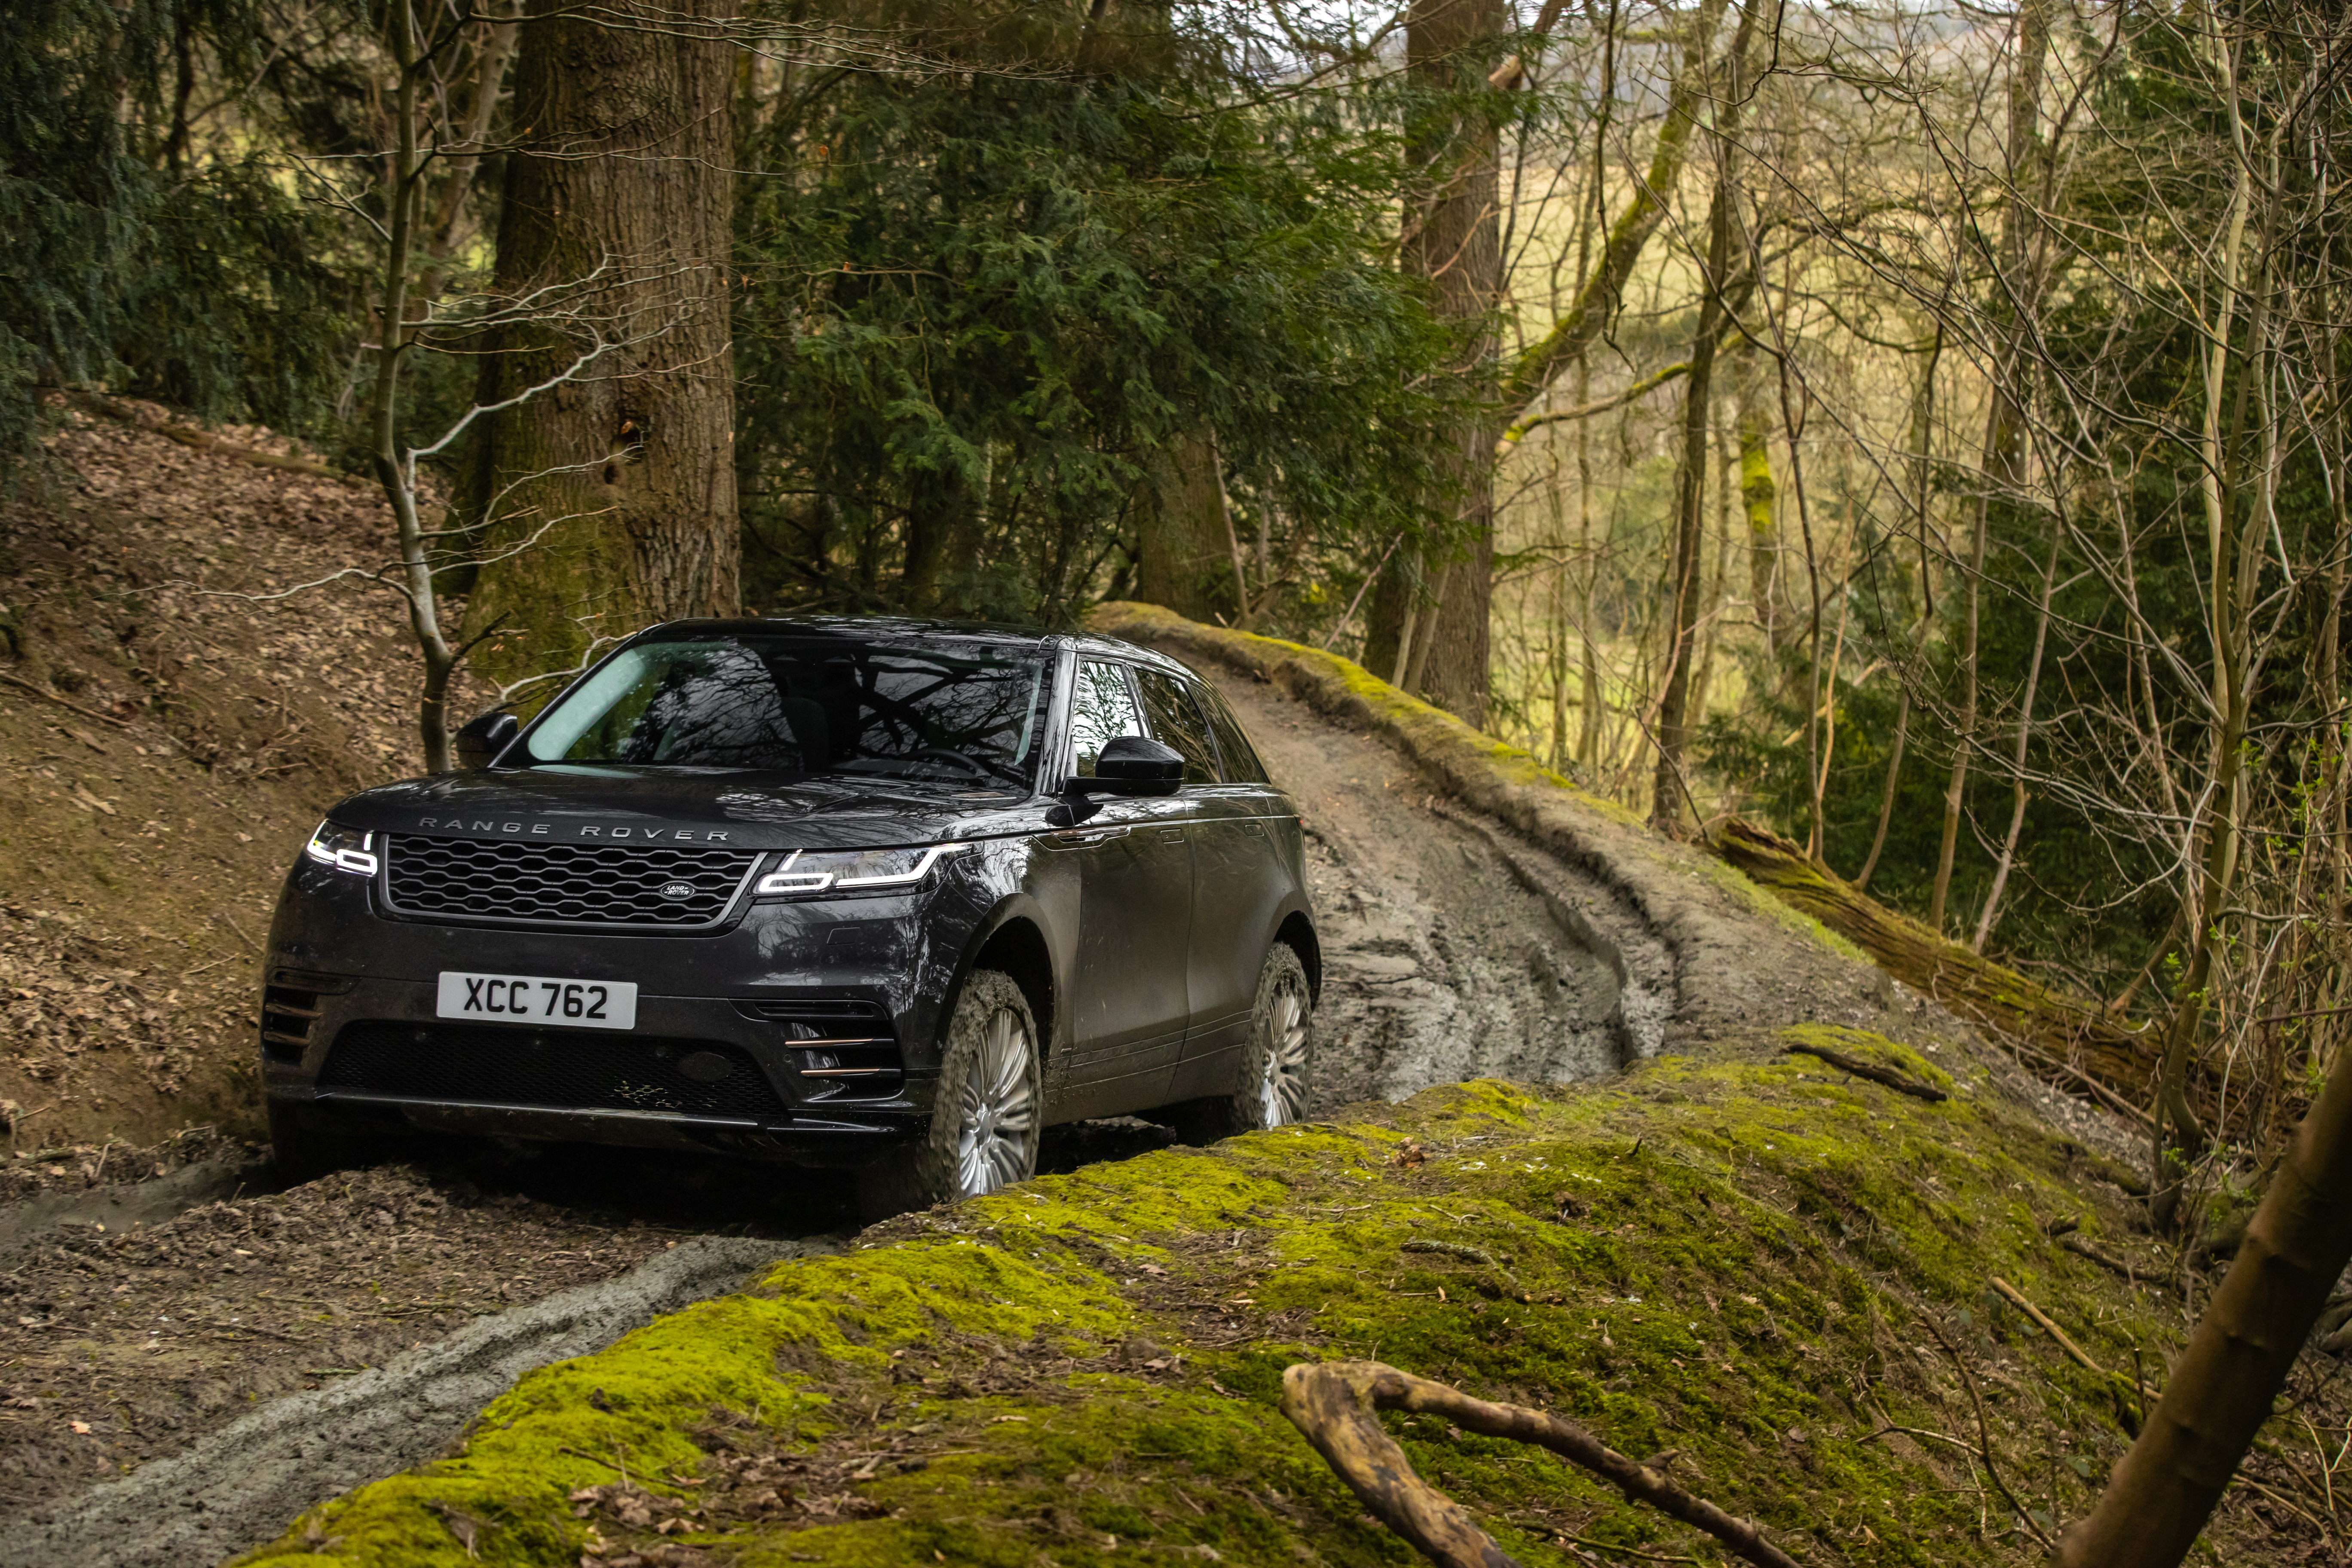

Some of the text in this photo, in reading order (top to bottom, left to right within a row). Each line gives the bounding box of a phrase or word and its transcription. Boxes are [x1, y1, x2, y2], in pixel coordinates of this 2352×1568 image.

[419, 818, 729, 841] RANGE ROVER
[464, 978, 607, 1020] XCC 762
